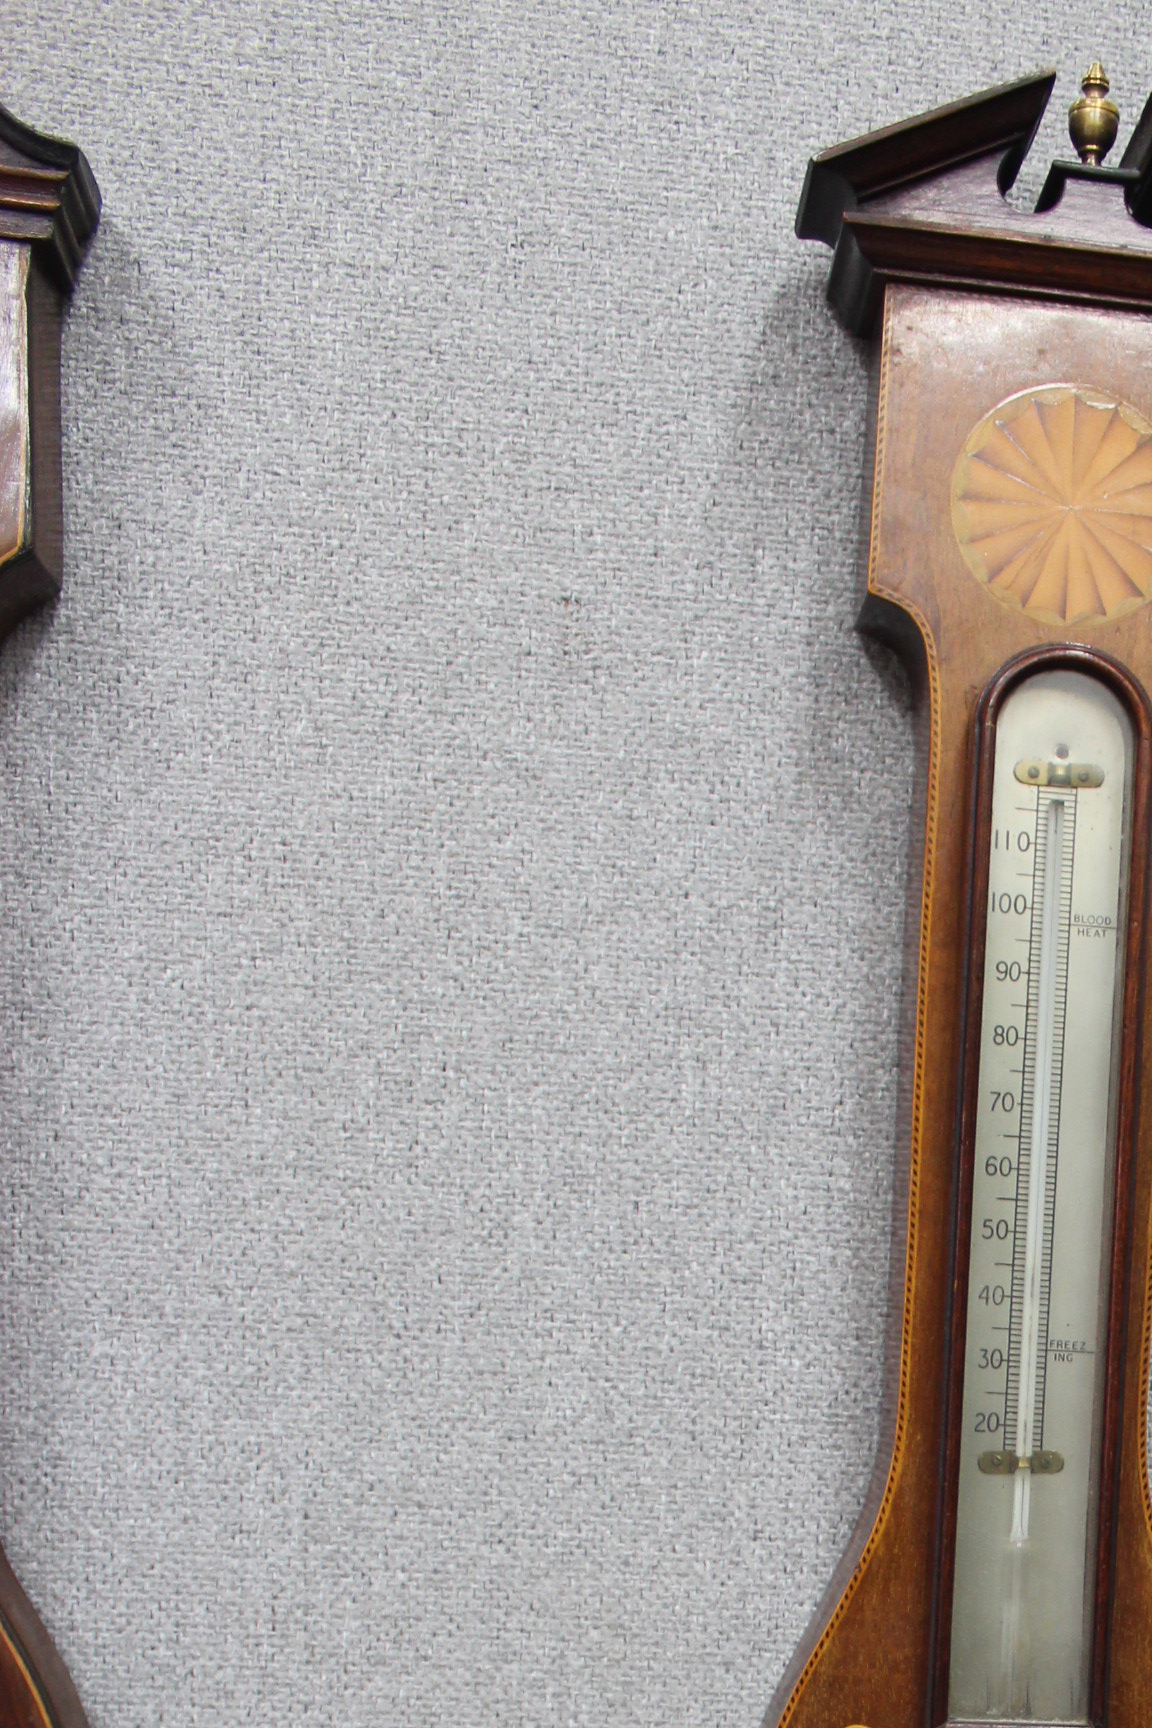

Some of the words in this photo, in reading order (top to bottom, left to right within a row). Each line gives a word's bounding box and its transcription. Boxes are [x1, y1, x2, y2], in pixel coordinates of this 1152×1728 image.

[994, 829, 1030, 852] 110
[991, 892, 1028, 915] 100
[1074, 914, 1112, 926] BLOOD
[1077, 928, 1108, 938] HEAT
[995, 961, 1021, 982] 90
[992, 1025, 1019, 1047] 80
[989, 1091, 1015, 1112] 70
[985, 1157, 1012, 1176] 60
[981, 1219, 1009, 1240] 50
[978, 1285, 1006, 1306] 40
[1049, 1340, 1087, 1351] FREEZ
[978, 1349, 1002, 1369] 30
[1053, 1353, 1074, 1362] ING
[974, 1413, 1000, 1433] 20
